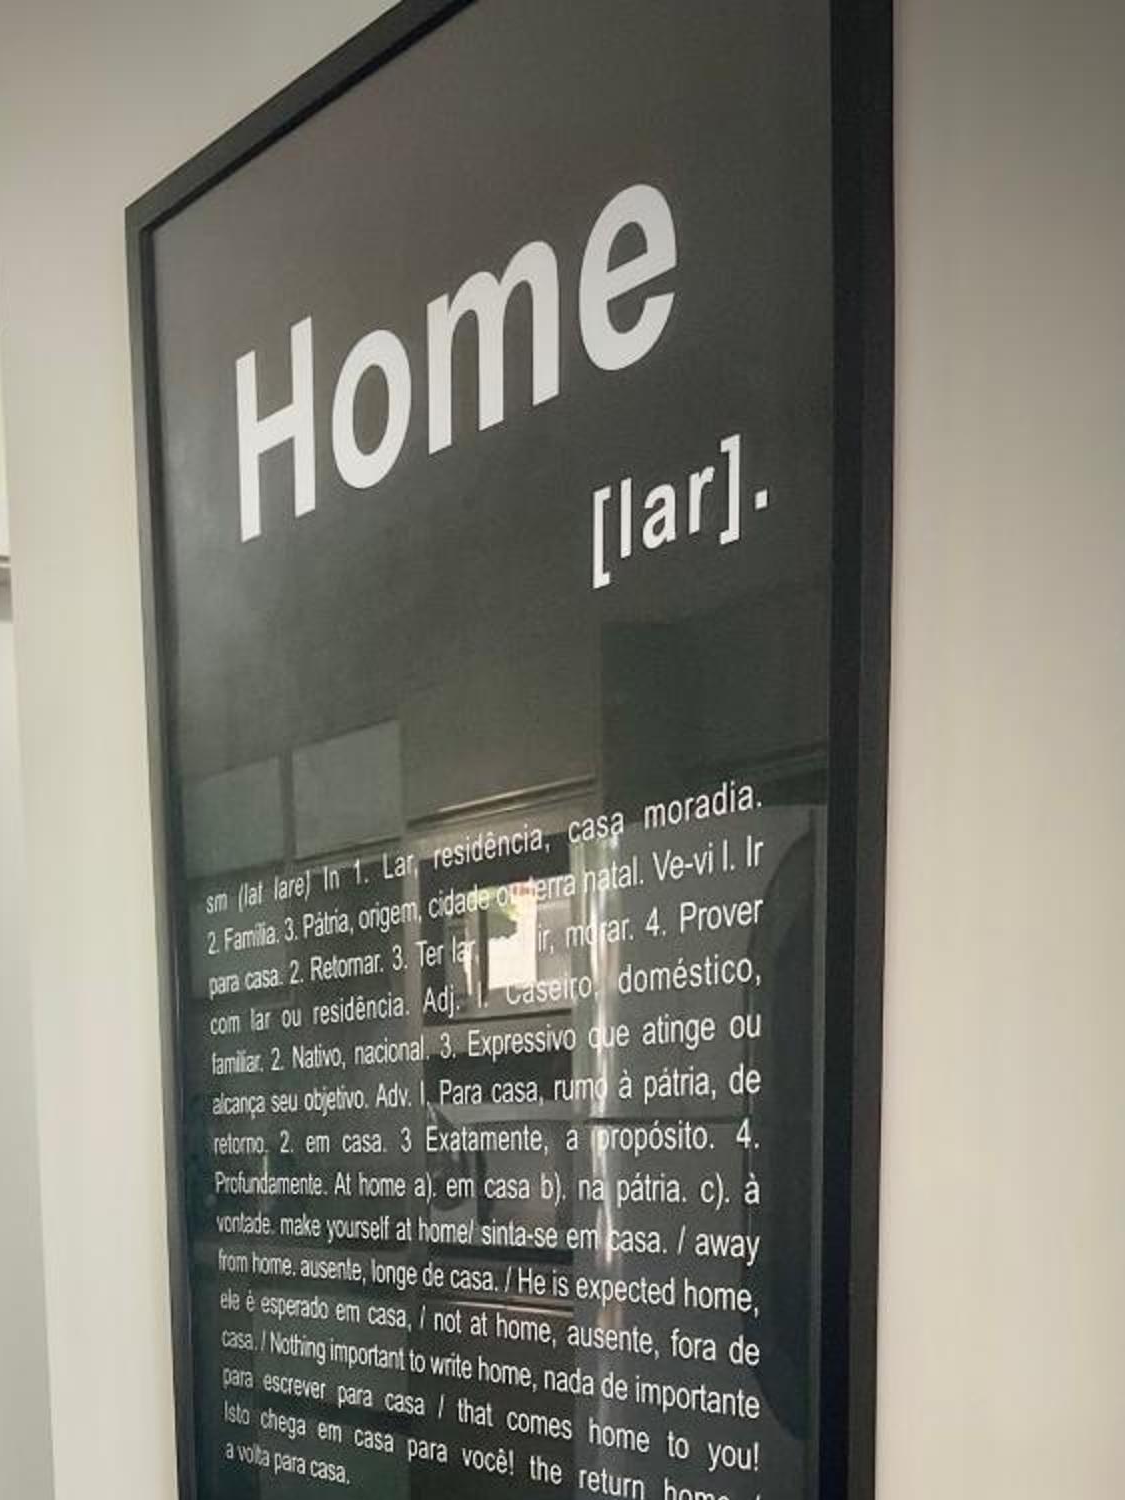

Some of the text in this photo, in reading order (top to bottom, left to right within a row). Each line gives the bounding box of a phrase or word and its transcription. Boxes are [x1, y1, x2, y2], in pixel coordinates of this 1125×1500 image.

[236, 184, 676, 543] Home
[592, 433, 769, 589] [lar].
[207, 891, 228, 913] sm
[275, 869, 310, 902] lare)
[355, 858, 369, 885] 1.
[383, 851, 418, 880] Lar,
[435, 824, 551, 871] residência,
[569, 812, 624, 846] casa
[645, 782, 763, 831] moradia.
[208, 930, 219, 954] 2.
[285, 916, 298, 942] 3.
[304, 908, 354, 939] Pátria,
[359, 901, 422, 934] origem,
[429, 884, 490, 920] cidade
[584, 856, 645, 895] natal.
[653, 843, 714, 885] Ve-vi
[748, 836, 763, 870] Ir
[210, 973, 240, 1001] para
[245, 967, 284, 990] casa.
[290, 959, 304, 984] 2.
[393, 944, 408, 971] 3.
[417, 940, 444, 968] Ter
[645, 907, 666, 939] 4.
[681, 899, 764, 935] Prover
[211, 1014, 240, 1035] com
[251, 1007, 271, 1031] lar
[282, 1007, 302, 1028] ou
[313, 991, 410, 1025] residência.
[423, 984, 460, 1019] Adj.
[619, 954, 762, 995] doméstico,
[271, 1046, 284, 1071] 2.
[293, 1043, 346, 1071] Nativo,
[355, 1034, 430, 1065] nacional.
[441, 1032, 456, 1059] 3.
[469, 1023, 577, 1063] Expressivo
[643, 1013, 716, 1051] atinge
[731, 1013, 762, 1040] ou
[213, 1091, 266, 1120] alcança
[271, 1093, 298, 1113] seu
[305, 1085, 369, 1117] objetivo.
[376, 1082, 411, 1108] Adv.
[440, 1079, 482, 1106] Para
[492, 1080, 544, 1108] casa,
[555, 1077, 608, 1102] rumo
[619, 1068, 633, 1099] à
[645, 1065, 717, 1106] pátria,
[729, 1062, 762, 1095] de
[281, 1129, 294, 1153] 2.
[306, 1134, 331, 1153] em
[343, 1133, 388, 1153] casa.
[401, 1126, 412, 1152] 3
[427, 1123, 549, 1157] Exatamente,
[566, 1128, 578, 1151] a
[599, 1119, 715, 1158] propósito.
[736, 1117, 760, 1149] 4.
[335, 1171, 351, 1196] At
[359, 1171, 406, 1197] home
[415, 1171, 437, 1205] a).
[447, 1177, 474, 1198] em
[485, 1178, 531, 1200] casa
[541, 1171, 567, 1208] b).
[579, 1178, 604, 1201] na
[617, 1171, 687, 1209] pátria.
[700, 1172, 731, 1212] c).
[745, 1171, 761, 1204] à
[281, 1212, 321, 1237] make
[326, 1215, 391, 1245] yourself
[397, 1216, 412, 1241] at
[483, 1218, 558, 1249] sinta-se
[567, 1227, 598, 1250] em
[611, 1229, 668, 1254] casa.
[695, 1232, 761, 1267] away
[219, 1248, 248, 1273] from
[301, 1256, 366, 1287] ausente,
[372, 1257, 418, 1292] longe
[423, 1260, 444, 1288] de
[451, 1268, 498, 1292] casa.
[518, 1266, 547, 1296] He
[553, 1268, 570, 1297] is
[576, 1273, 676, 1308] expected
[685, 1276, 760, 1318] home,
[221, 1287, 240, 1311] ele
[261, 1295, 329, 1322] esperado
[336, 1302, 360, 1324] em
[368, 1305, 412, 1334] casa,
[435, 1307, 462, 1334] not
[471, 1310, 488, 1337] at
[497, 1311, 557, 1350] home,
[568, 1323, 660, 1361] ausente,
[671, 1326, 717, 1360] fora
[730, 1331, 761, 1365] de
[223, 1330, 258, 1351] casa.
[271, 1331, 326, 1367] Nothing
[331, 1338, 405, 1372] important
[410, 1347, 426, 1374] to
[431, 1352, 473, 1380] write
[479, 1355, 537, 1394] home,
[545, 1365, 594, 1396] nada
[601, 1369, 628, 1401] de
[636, 1373, 760, 1418] importante
[223, 1368, 253, 1393] para
[263, 1374, 326, 1402] escrever
[338, 1385, 373, 1411] para
[385, 1392, 425, 1417] casa
[458, 1397, 494, 1428] that
[507, 1410, 573, 1441] comes
[589, 1415, 650, 1453] home
[668, 1427, 690, 1459] to
[708, 1439, 760, 1473] you!
[261, 1409, 307, 1442] chega
[318, 1422, 343, 1445] em
[354, 1429, 394, 1454] casa
[408, 1438, 448, 1466] para
[463, 1446, 515, 1477] você!
[530, 1453, 562, 1486] the
[578, 1465, 645, 1500] return
[226, 1443, 350, 1485] a volta para casa.
